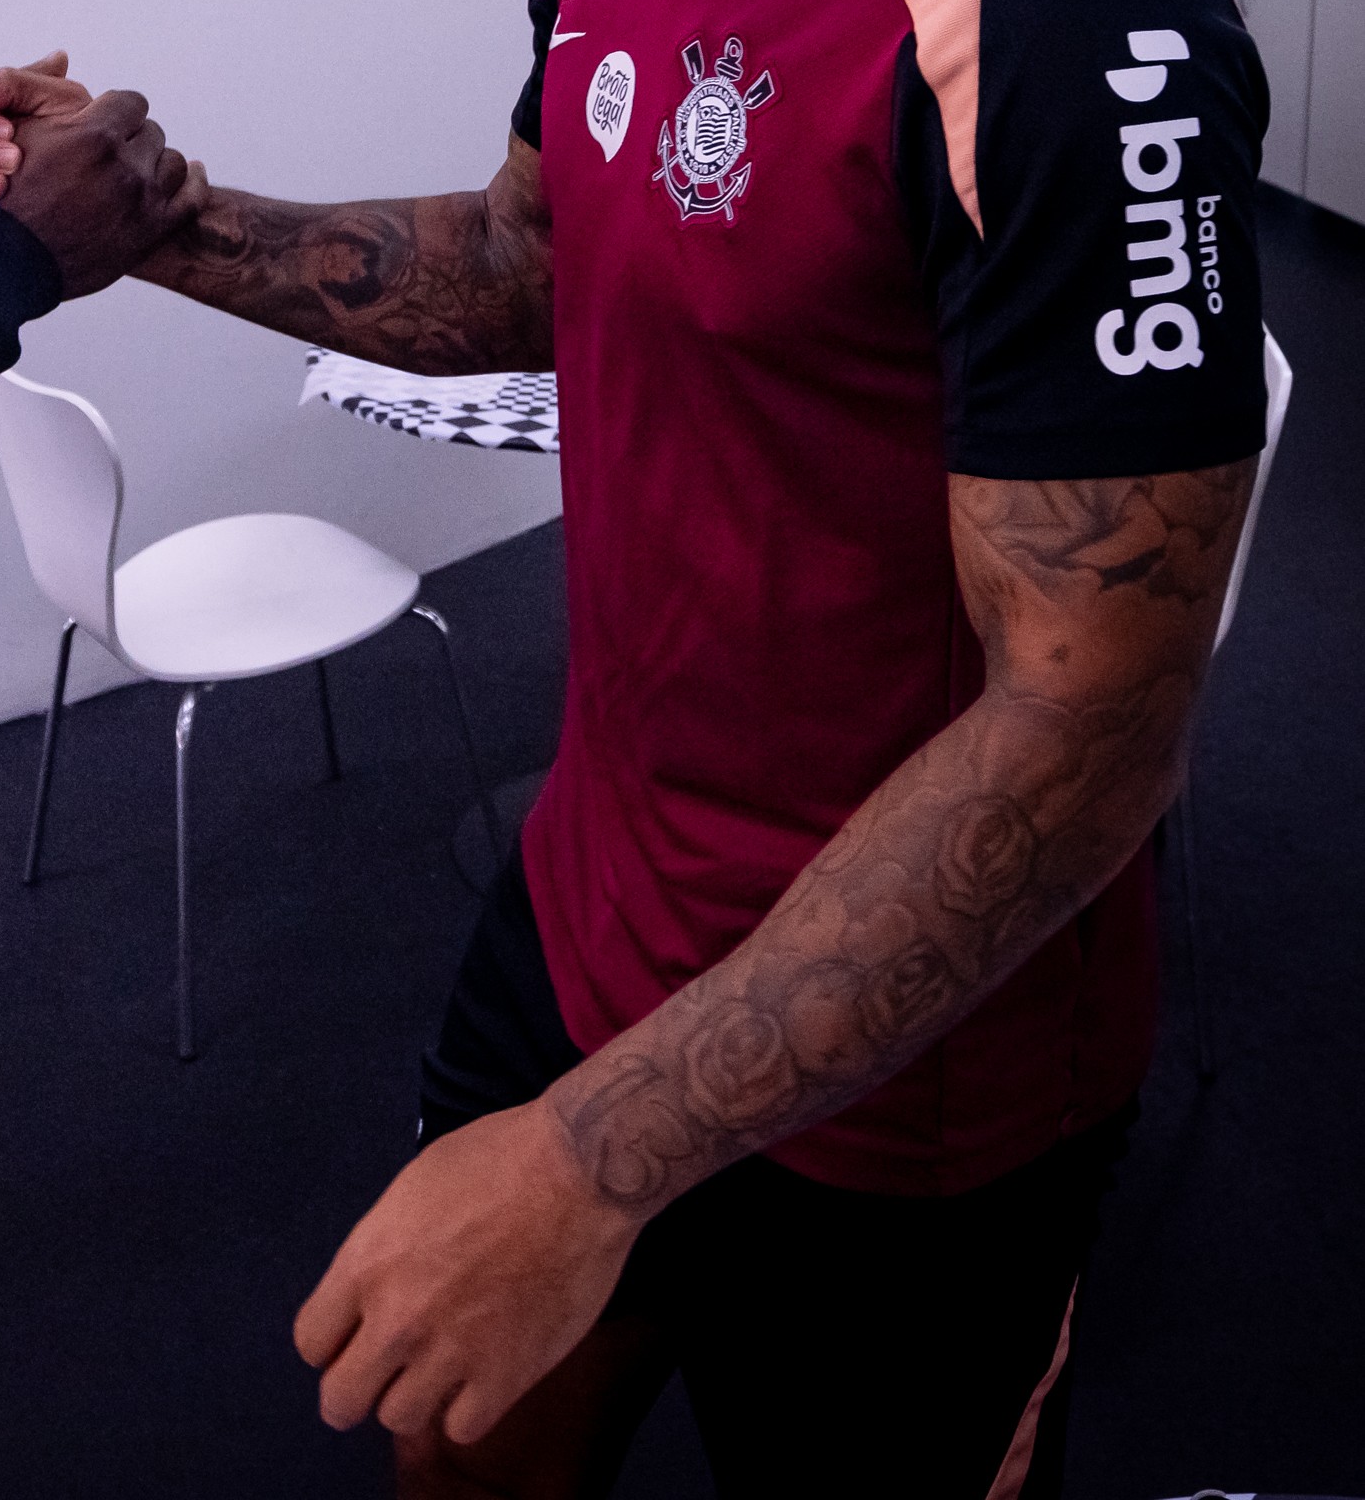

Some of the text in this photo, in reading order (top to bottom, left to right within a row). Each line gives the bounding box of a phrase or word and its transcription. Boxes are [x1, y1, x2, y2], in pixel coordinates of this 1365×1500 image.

[597, 62, 630, 102] Broto
[1095, 117, 1205, 376] bmg
[1197, 195, 1223, 315] banco
